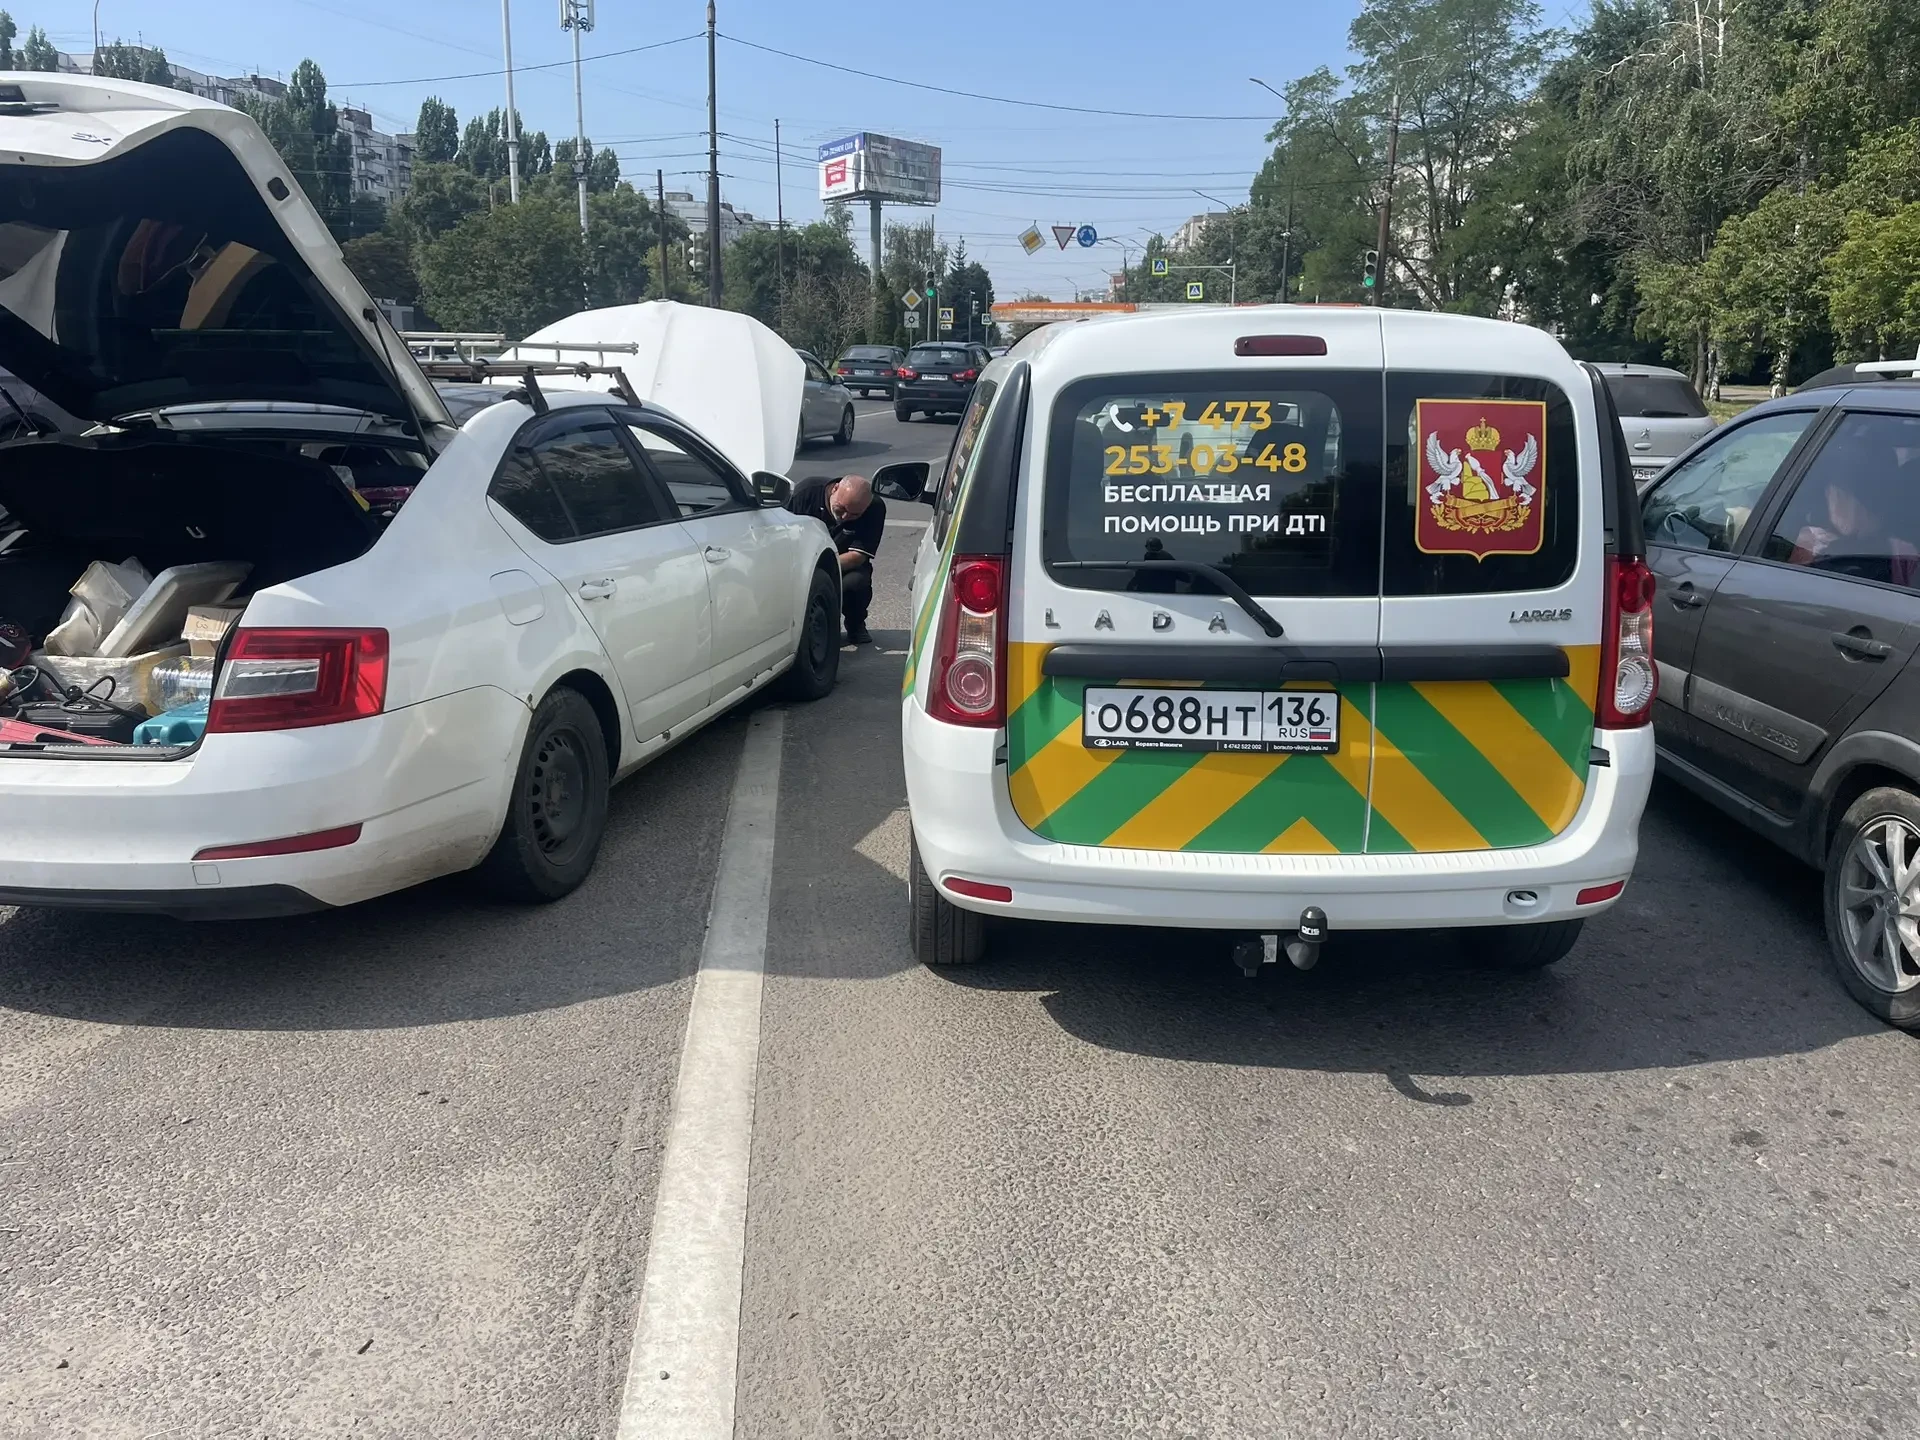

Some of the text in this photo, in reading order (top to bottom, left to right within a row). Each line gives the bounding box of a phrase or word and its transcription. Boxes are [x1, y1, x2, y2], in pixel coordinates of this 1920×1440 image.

[1140, 401, 1272, 431] +7 473
[1105, 443, 1307, 475] 253-03-48
[1104, 484, 1270, 503] БЕСПЛАТНАЯ
[1104, 515, 1221, 535] ПОМОЩЬ
[1228, 515, 1279, 533] ПРИ
[1045, 608, 1230, 633] LADA
[1509, 608, 1573, 623] LARGUS
[1268, 697, 1326, 727] 136
[1279, 728, 1308, 738] RUS
